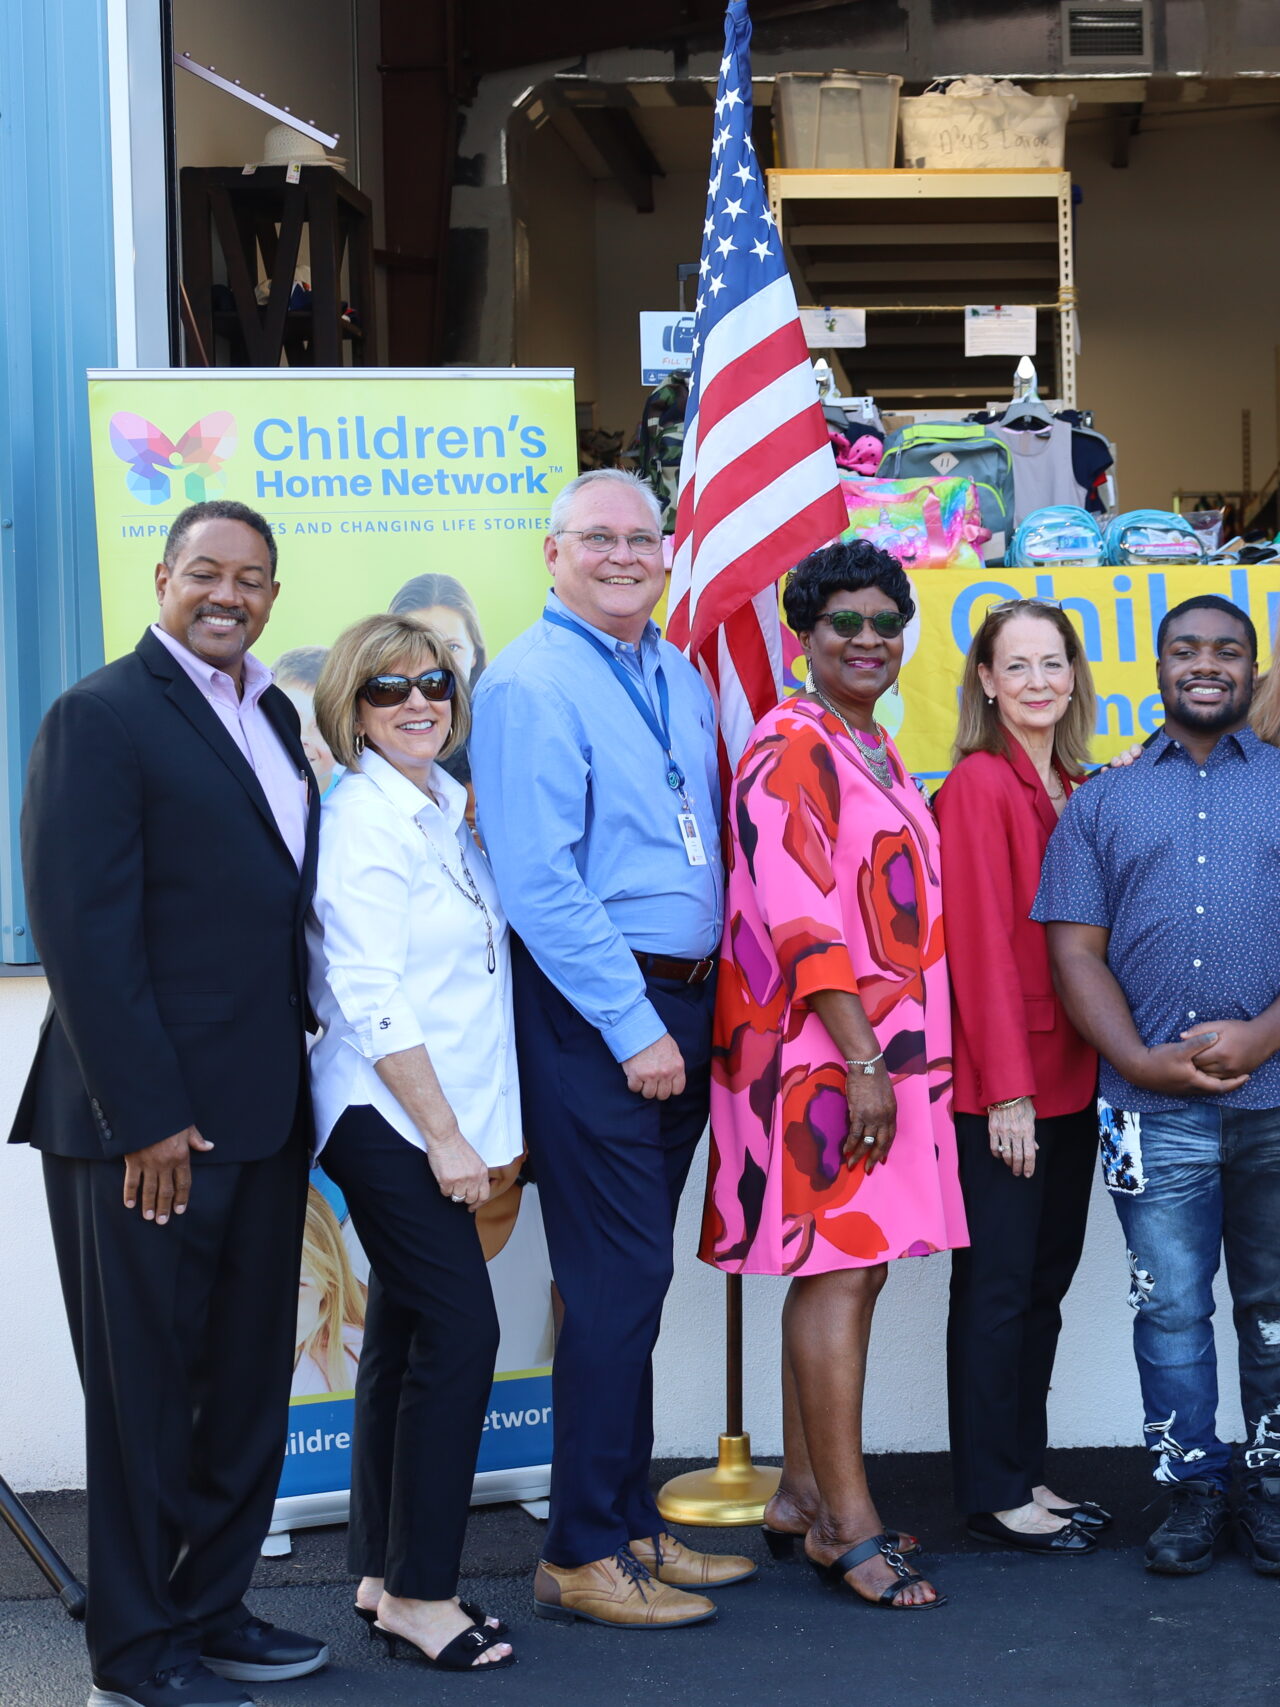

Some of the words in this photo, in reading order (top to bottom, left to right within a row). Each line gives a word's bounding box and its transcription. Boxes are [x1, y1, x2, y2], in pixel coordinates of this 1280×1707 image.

[253, 414, 548, 462] Children's
[256, 470, 372, 498] Home
[382, 465, 548, 496] Network
[294, 521, 332, 534] AND
[340, 520, 435, 534] CHANGING
[442, 518, 476, 532] LIFE
[484, 518, 552, 530] STORIES
